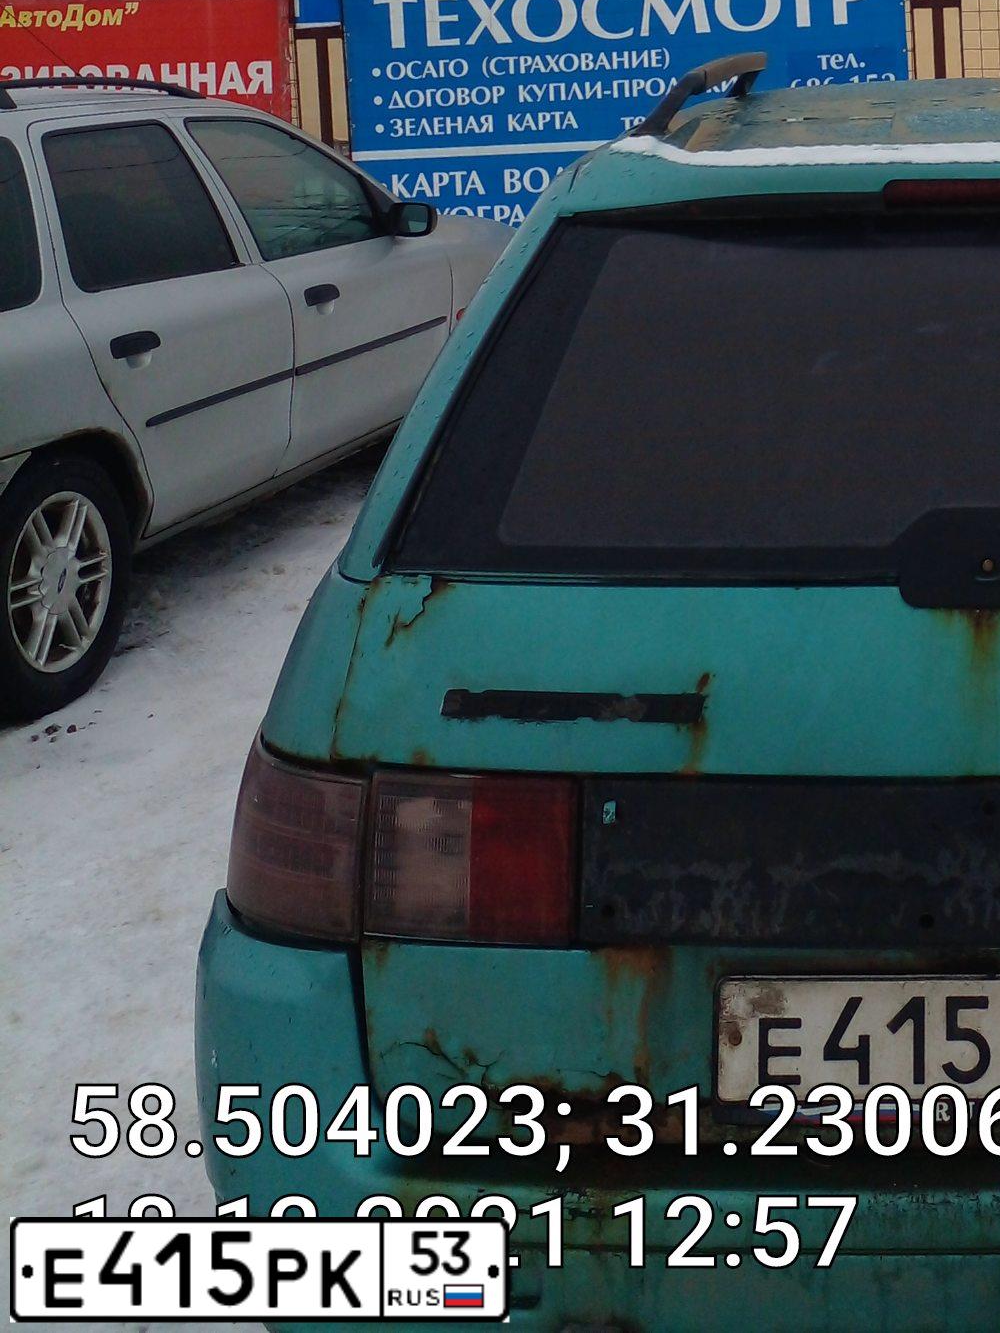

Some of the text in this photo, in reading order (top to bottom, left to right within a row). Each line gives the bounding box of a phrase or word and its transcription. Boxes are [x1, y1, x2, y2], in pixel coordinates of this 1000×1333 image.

[386, 48, 670, 81] ОСАГО (СТРАХОВАНИЕ)
[817, 52, 866, 71] тел.
[388, 86, 505, 110] ДОГОВОР
[389, 112, 579, 138] ЗЕЛЕНАЯ КАРТА
[391, 166, 565, 199] КАРТА ВО
